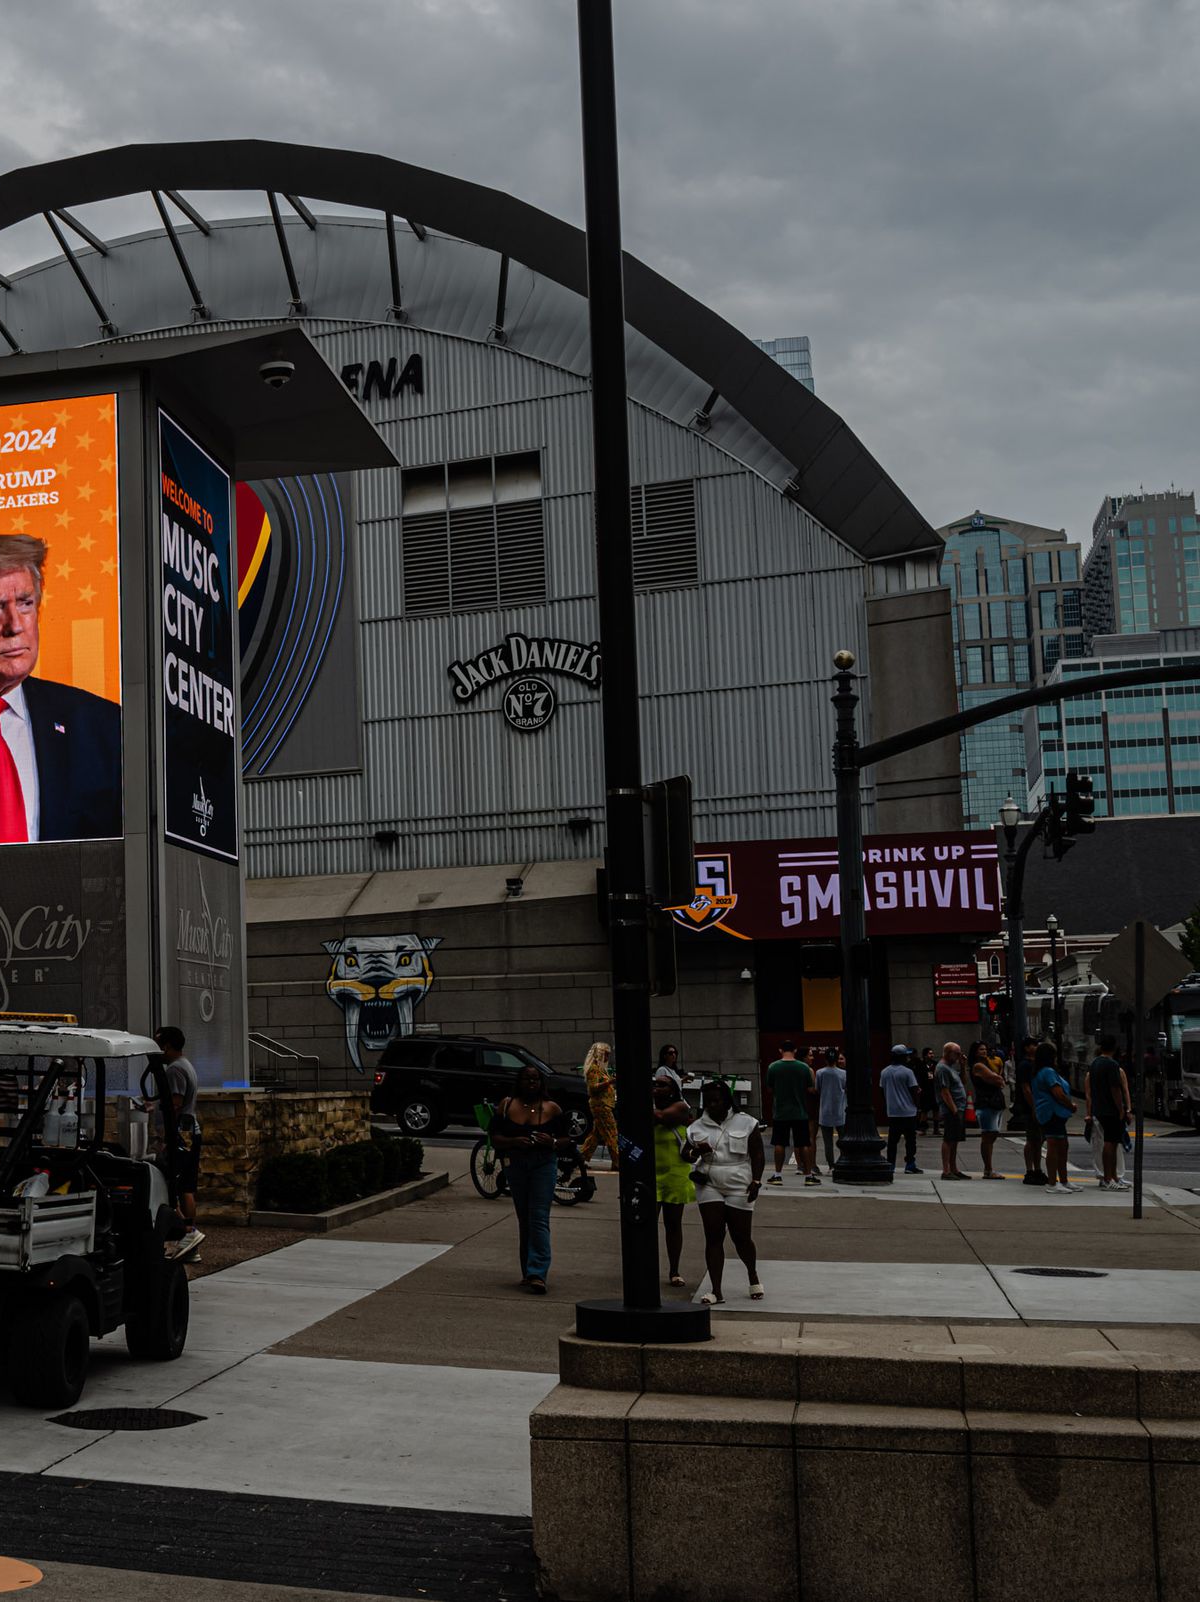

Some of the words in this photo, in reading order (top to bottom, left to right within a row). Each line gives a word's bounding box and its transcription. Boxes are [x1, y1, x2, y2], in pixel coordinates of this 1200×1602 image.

[161, 472, 202, 526] WELCOME
[202, 503, 213, 535] TO
[163, 512, 220, 603] MUSIC
[163, 583, 204, 653] CITY
[165, 651, 234, 738] CENTER
[450, 648, 511, 698] JACK
[518, 682, 538, 692] OLD
[515, 716, 544, 726] BRAND
[862, 846, 926, 864] RINK
[934, 845, 965, 861] UP
[779, 867, 994, 928] SMSHVIL
[13, 904, 91, 961] City
